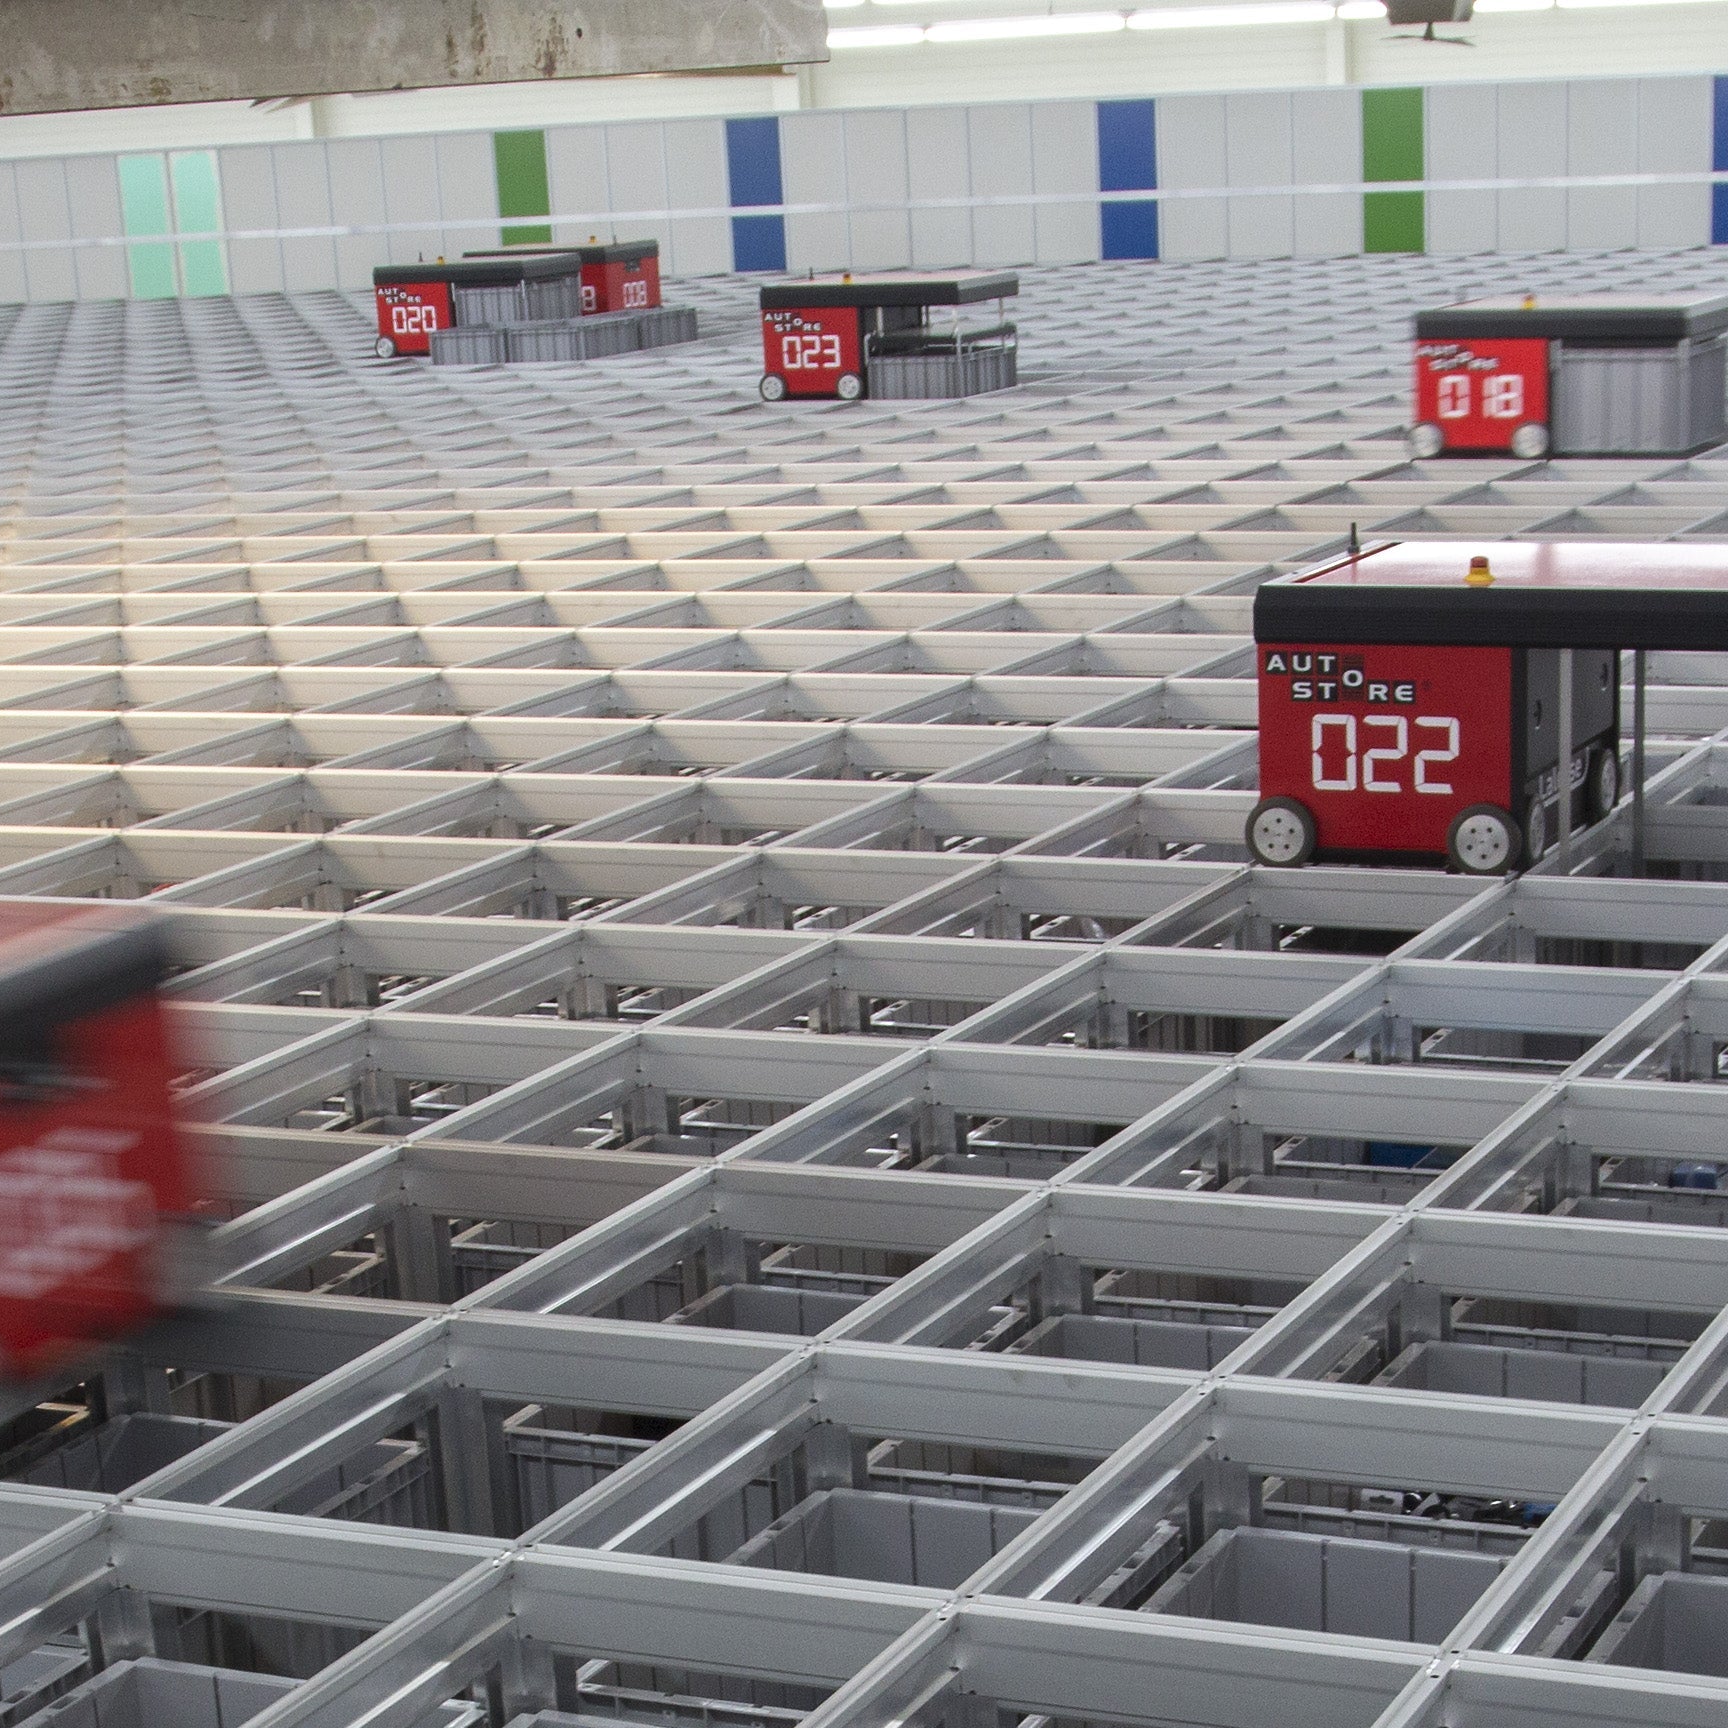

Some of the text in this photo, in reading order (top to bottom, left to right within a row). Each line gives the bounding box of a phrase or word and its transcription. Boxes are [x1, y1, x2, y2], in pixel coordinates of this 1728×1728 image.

[392, 305, 437, 333] 020
[782, 334, 841, 369] 023
[1312, 713, 1460, 794] 022
